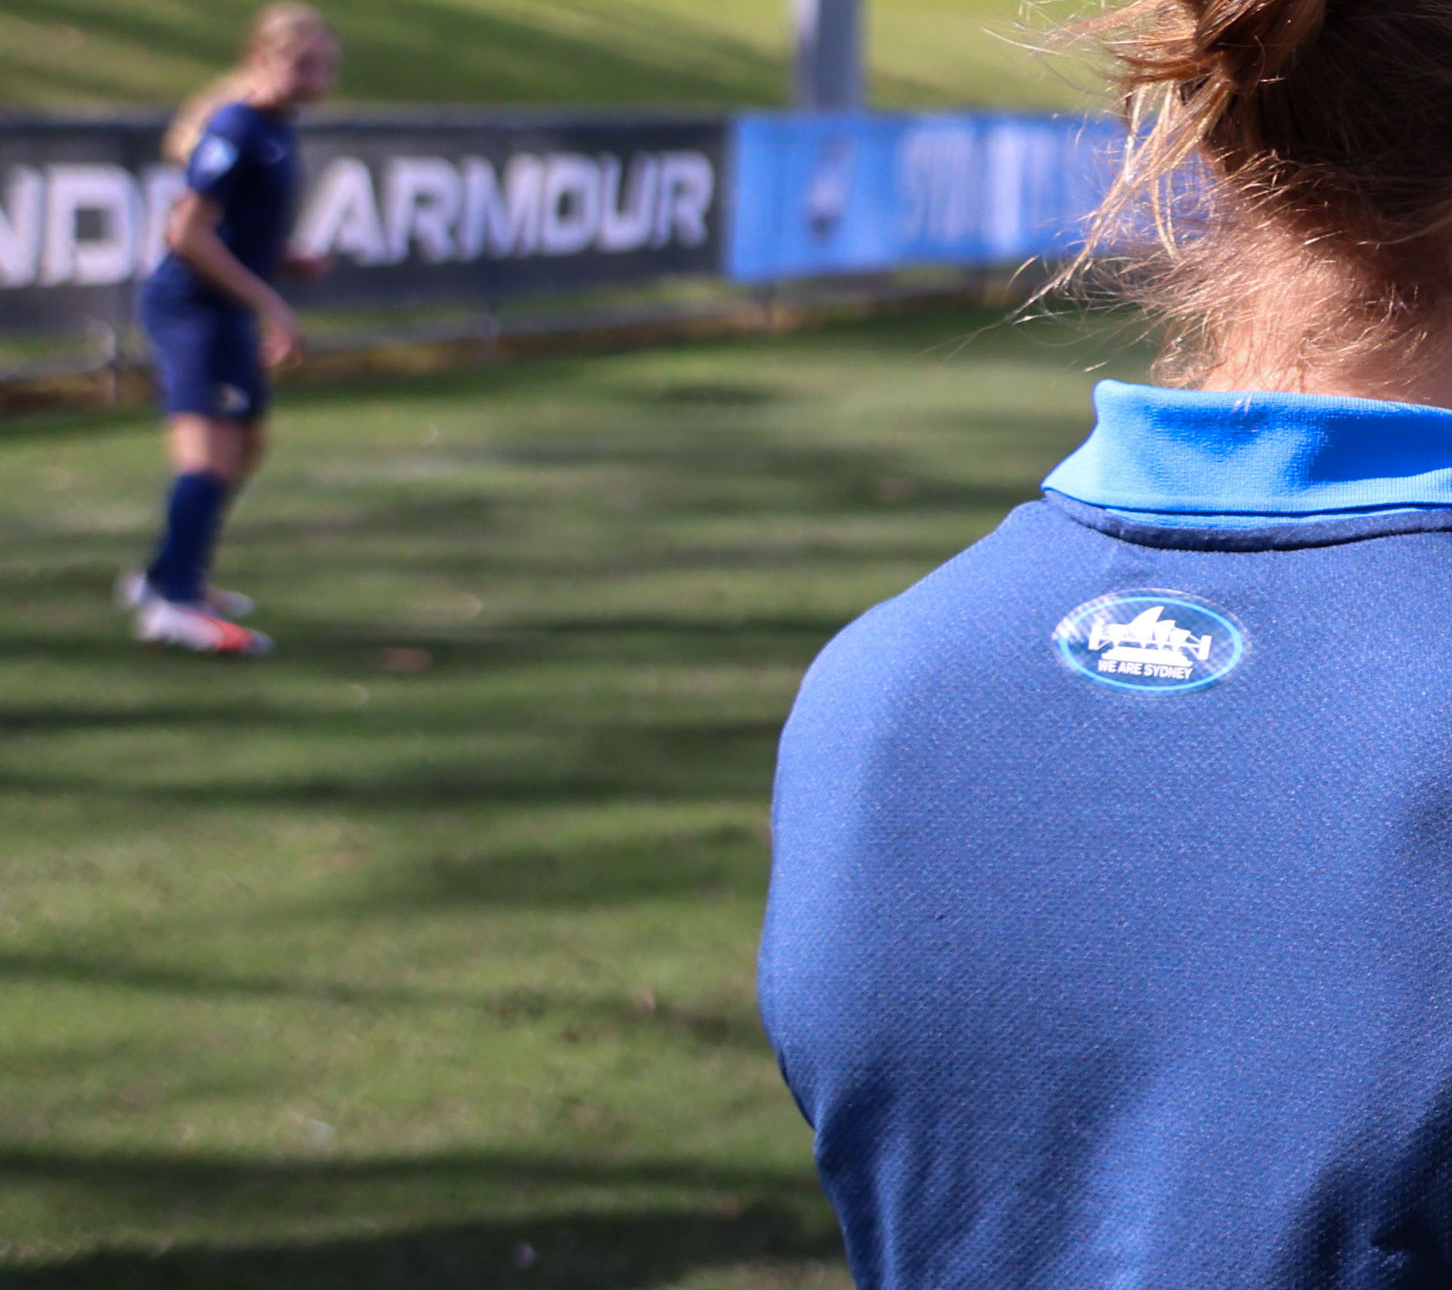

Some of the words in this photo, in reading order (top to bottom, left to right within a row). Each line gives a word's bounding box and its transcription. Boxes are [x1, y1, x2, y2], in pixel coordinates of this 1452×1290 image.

[298, 152, 714, 266] ARMOUR
[1098, 661, 1117, 672] WE
[1118, 662, 1142, 675] ARE
[1143, 664, 1193, 679] SYDNEY
